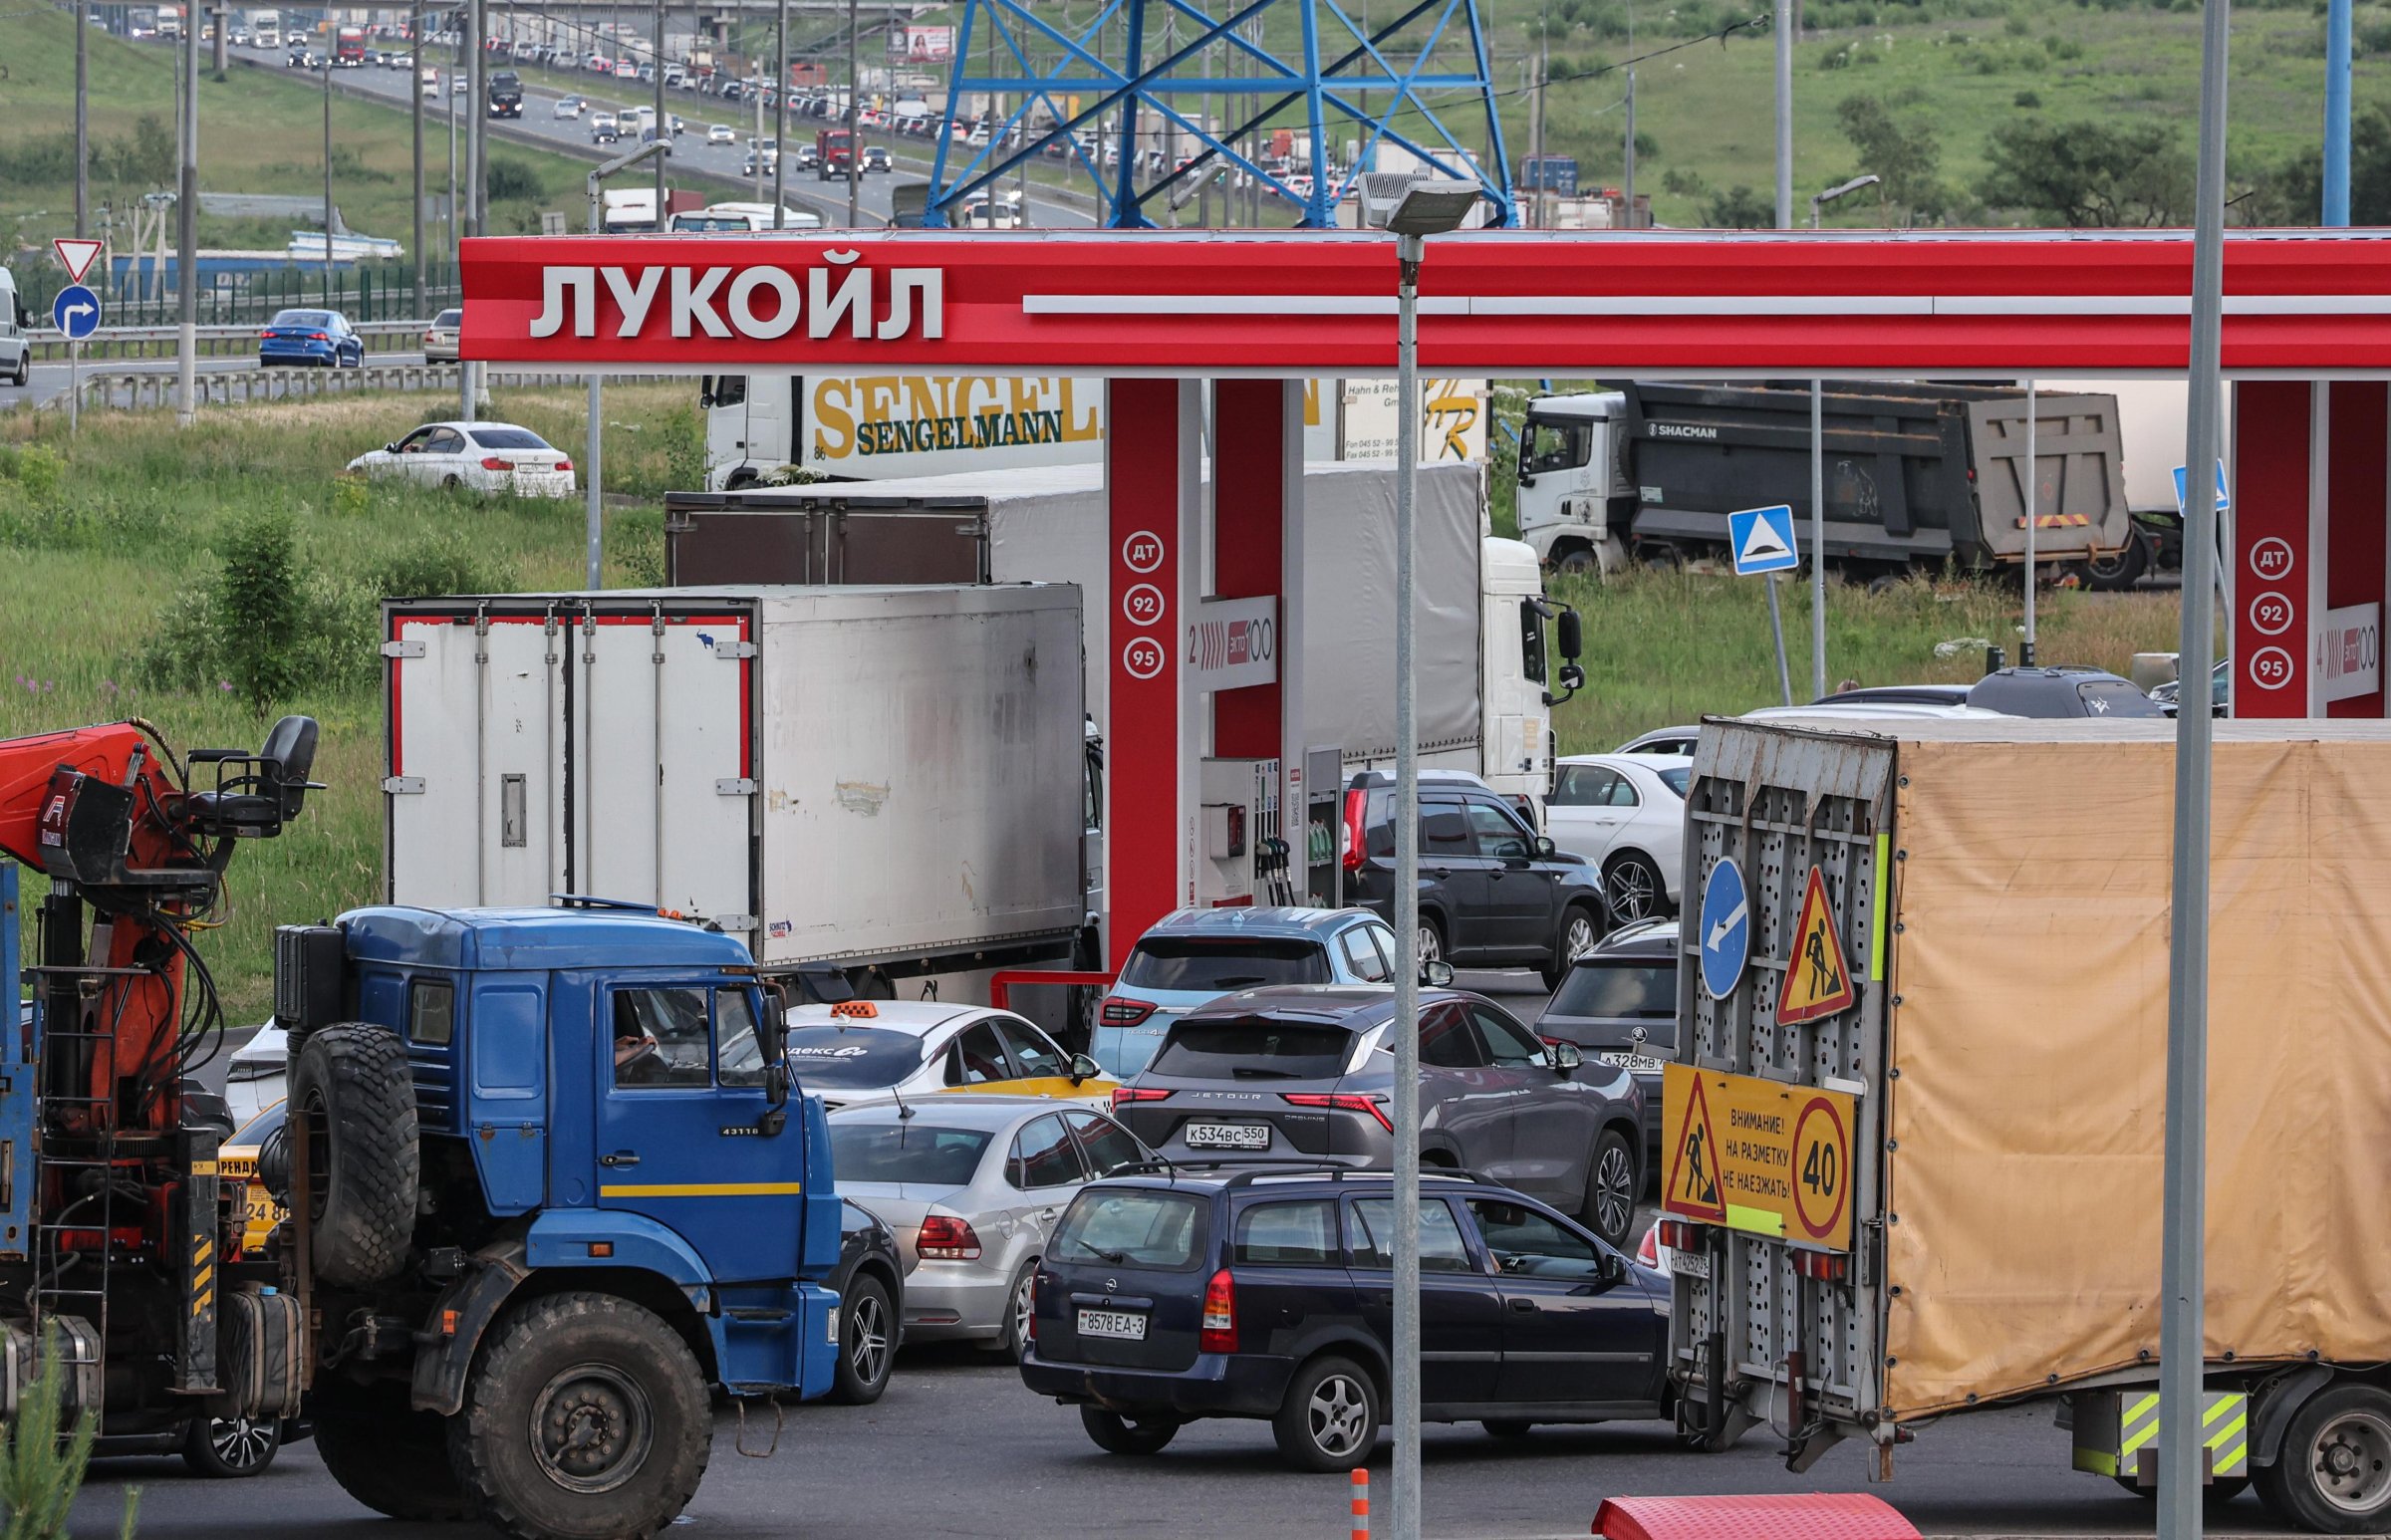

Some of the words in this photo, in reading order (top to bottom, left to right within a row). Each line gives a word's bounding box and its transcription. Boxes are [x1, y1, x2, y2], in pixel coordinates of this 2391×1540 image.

[529, 248, 943, 340] ЛУКОЙЛ
[1348, 385, 1371, 395] Hahn
[1373, 385, 1380, 394] &
[857, 409, 1063, 455] SENGELMANN
[1658, 425, 1717, 438] SHACMAN
[1358, 439, 1370, 448] 045
[814, 445, 826, 460] 86
[1358, 450, 1370, 459] 045
[1133, 545, 1156, 561] ДТ
[2259, 551, 2284, 568] ДТ
[1133, 598, 1155, 613] 92
[2260, 606, 2282, 622] 92
[1189, 625, 1196, 663] 2
[1229, 636, 1245, 653] ЭКТО
[1245, 618, 1272, 663] 100
[1133, 650, 1155, 666] 95
[2316, 633, 2323, 673] 4
[2344, 644, 2357, 662] ЭКТО
[2259, 660, 2283, 676] 95
[1730, 1109, 1784, 1135] ВНИМАНИЕ!
[1244, 1128, 1264, 1139] 550
[1726, 1140, 1738, 1156] НА
[1741, 1142, 1788, 1166] РАЗМЕТКУ
[1802, 1140, 1836, 1196] 40
[1723, 1169, 1733, 1187] НЕ
[1737, 1171, 1790, 1198] НАЕЗЖАТЬ!
[246, 1202, 266, 1221] 24
[1088, 1313, 1113, 1331] 8578
